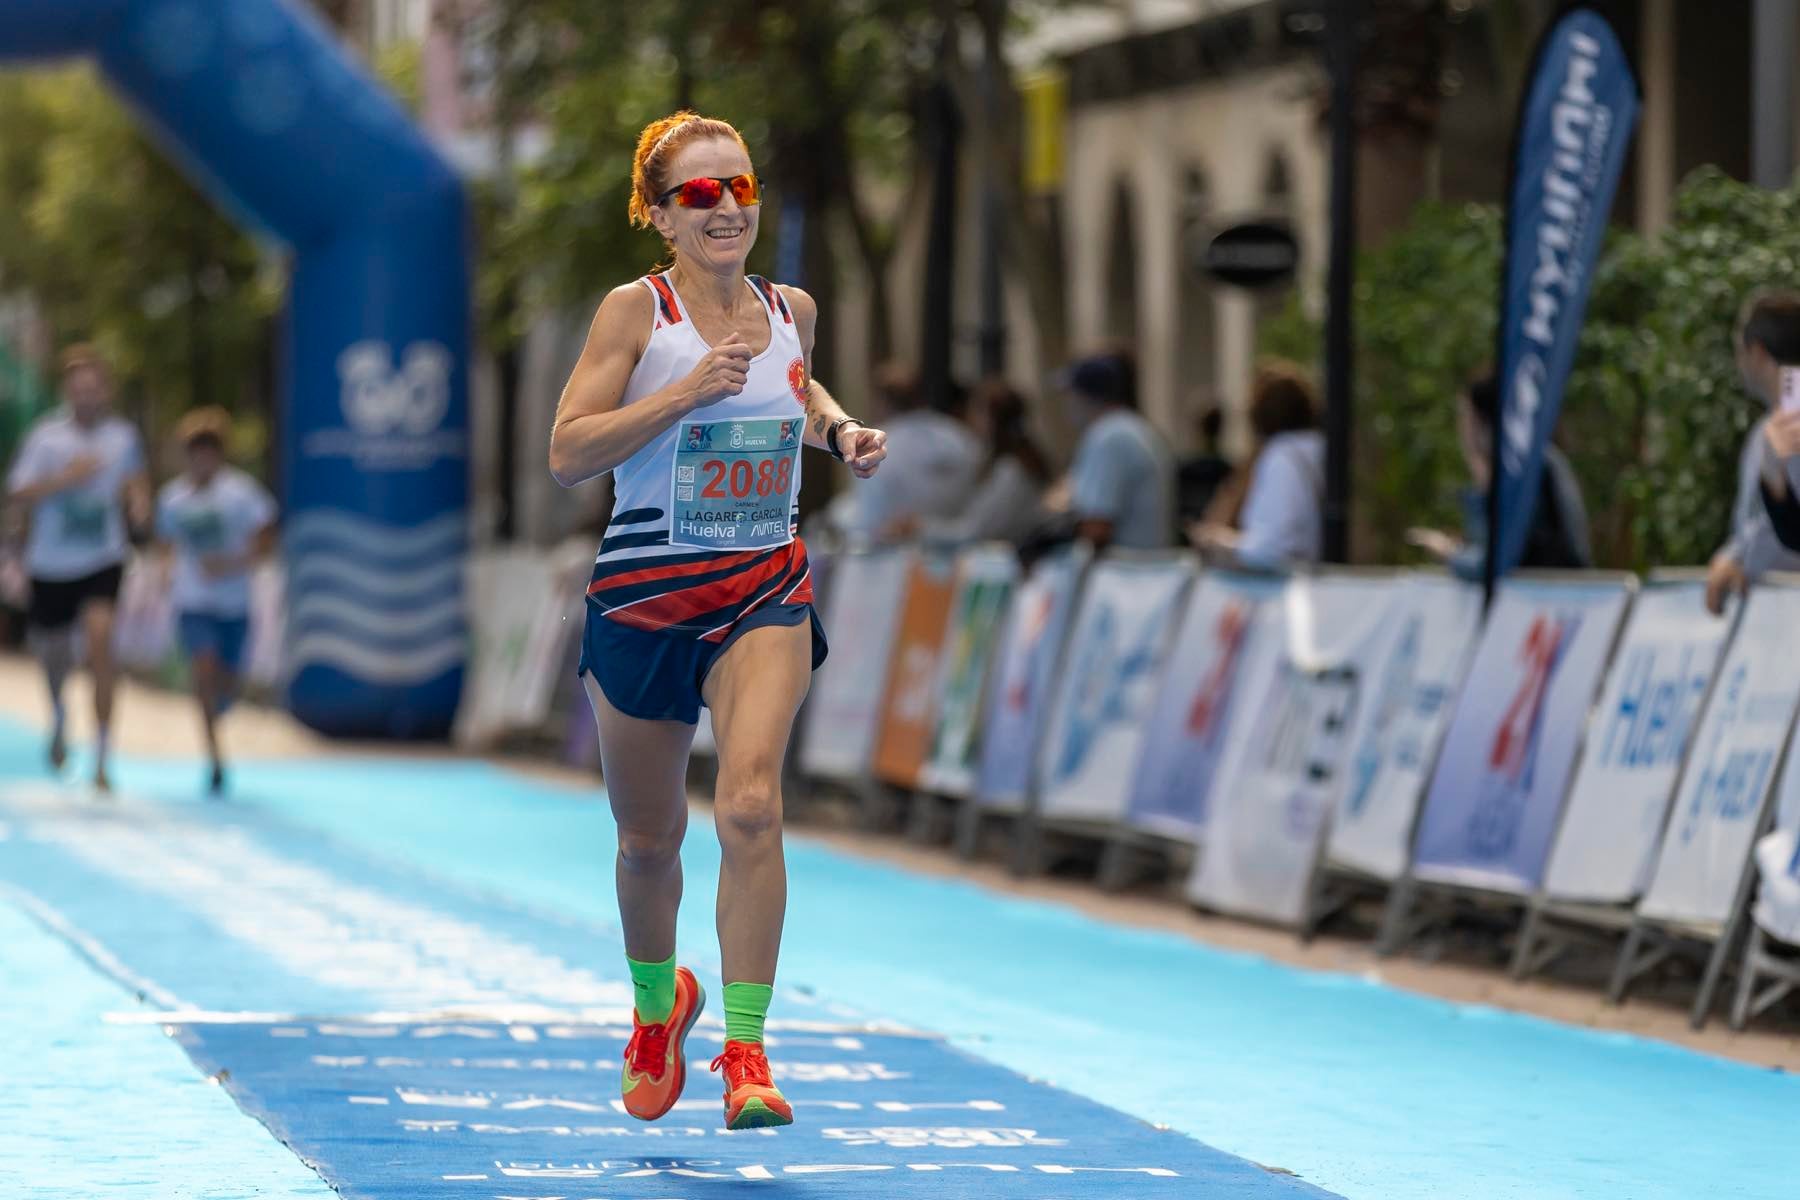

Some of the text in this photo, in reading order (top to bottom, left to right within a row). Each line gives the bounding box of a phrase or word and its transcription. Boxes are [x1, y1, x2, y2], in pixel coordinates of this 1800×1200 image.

[688, 425, 714, 441] 5K
[780, 421, 799, 440] 5K
[702, 456, 792, 498] 2088
[751, 508, 783, 521] GARCIA
[680, 520, 736, 538] Huelva
[750, 520, 785, 537] AVATEL
